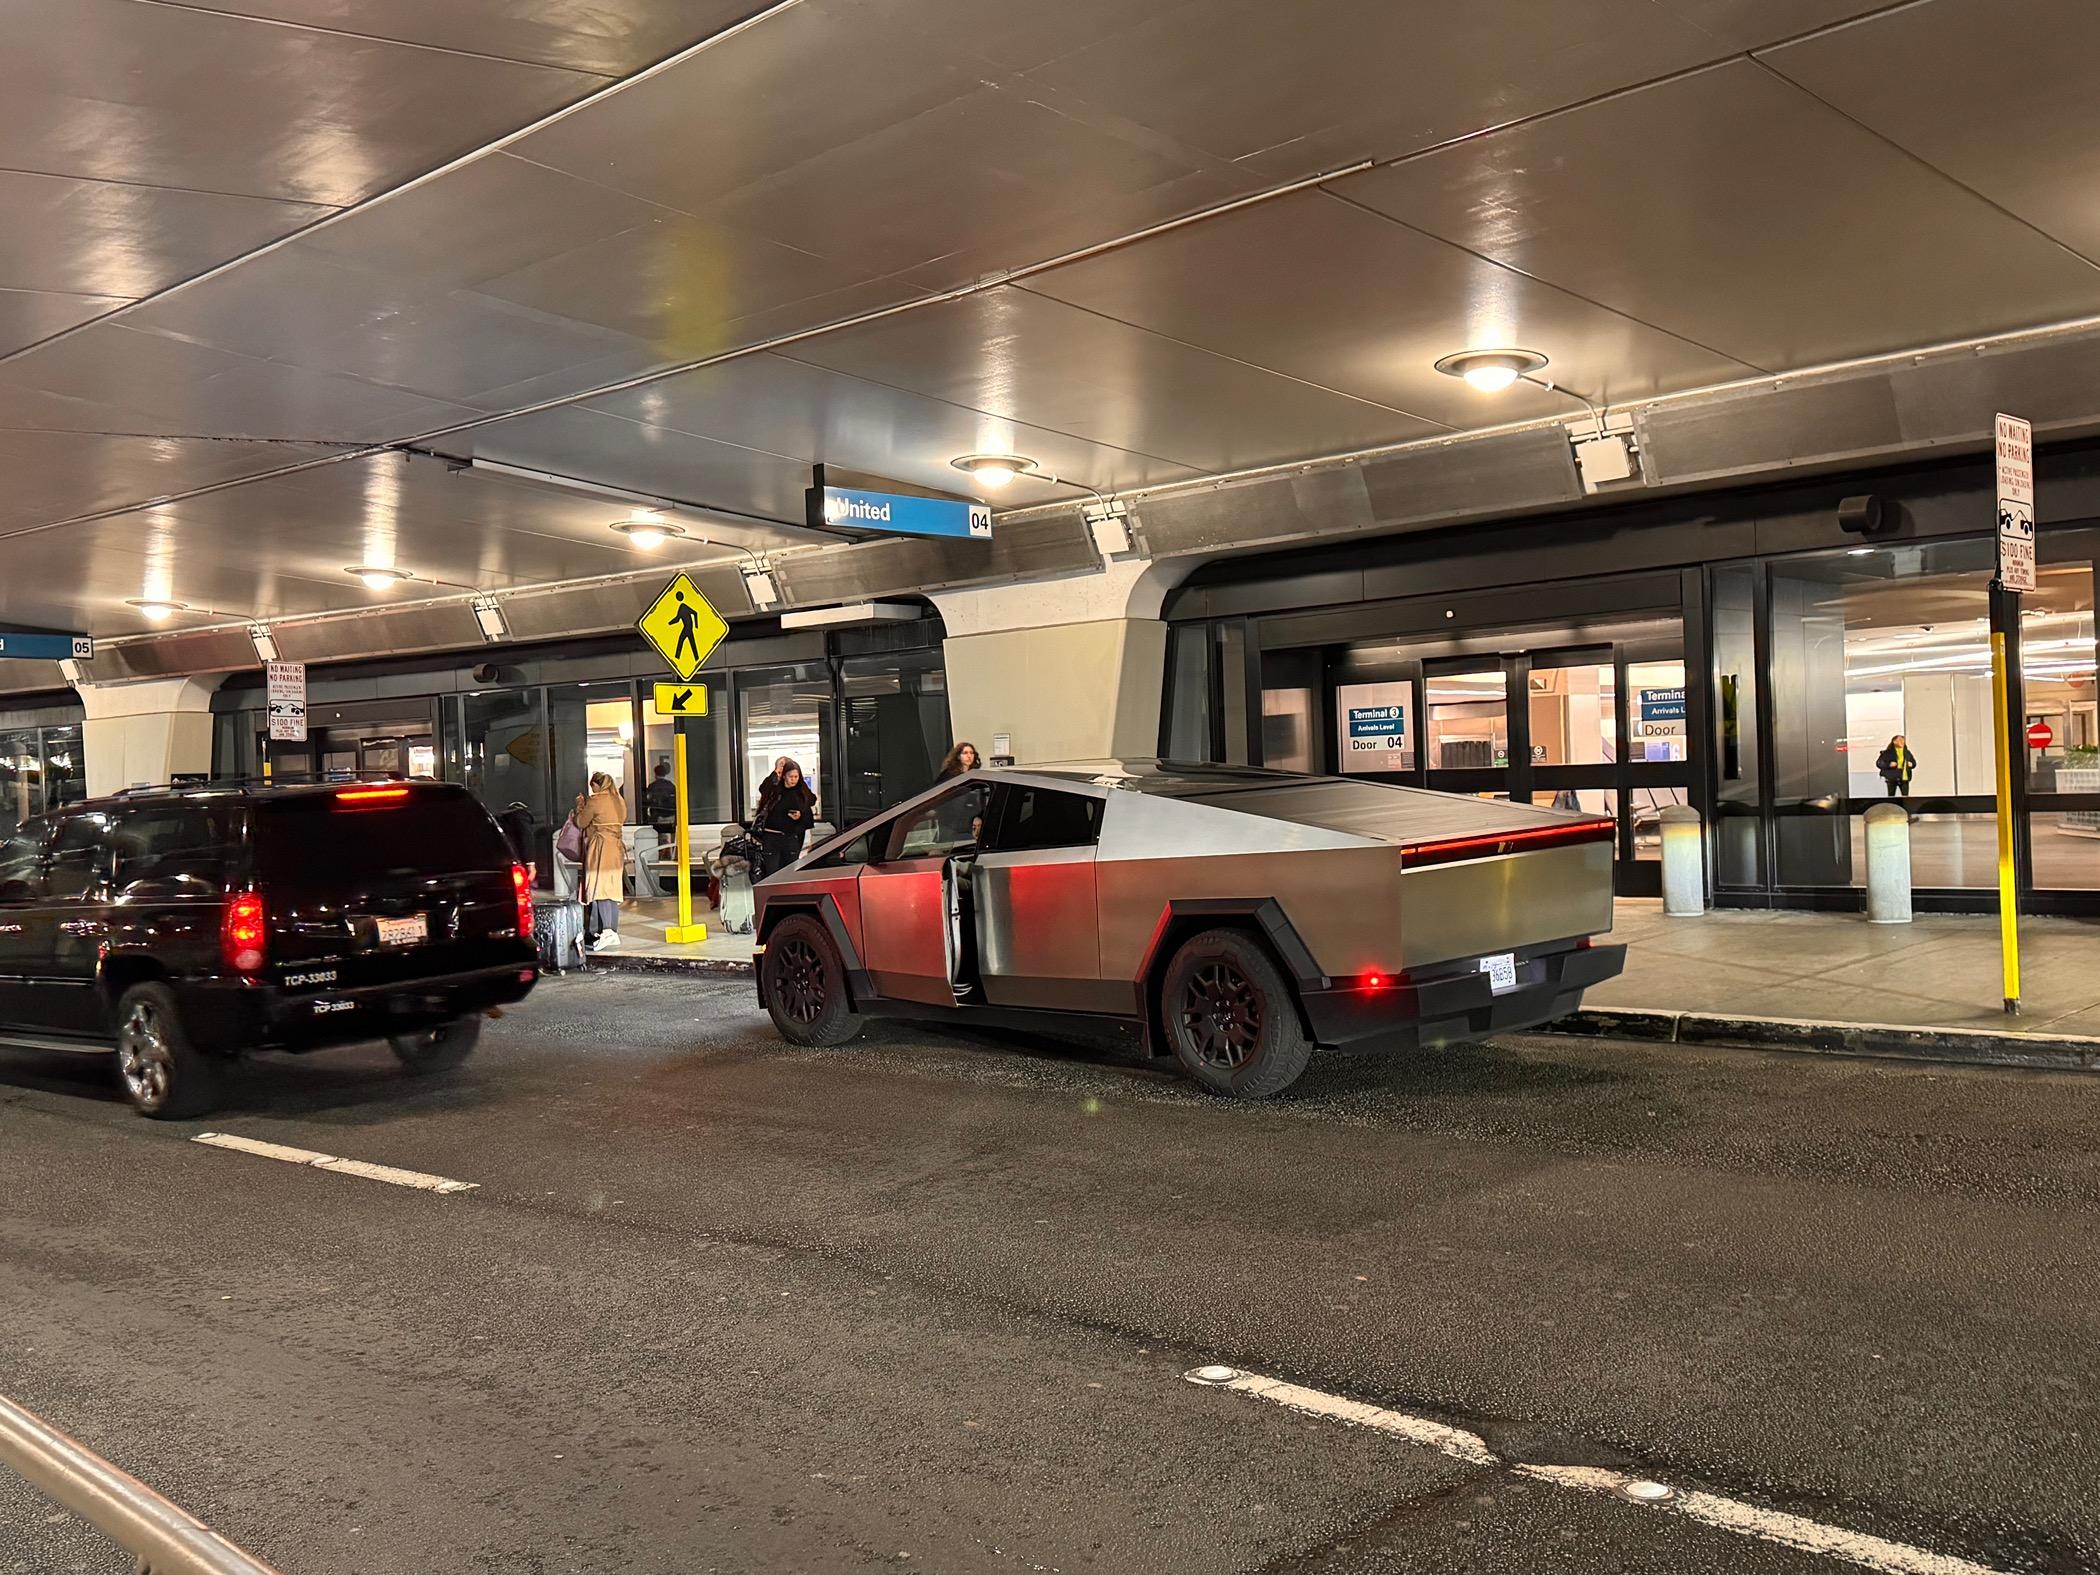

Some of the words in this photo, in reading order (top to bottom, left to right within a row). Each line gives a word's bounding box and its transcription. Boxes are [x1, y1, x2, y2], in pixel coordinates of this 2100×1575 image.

[1999, 422, 2007, 438] NO
[2008, 424, 2029, 444] WAITING
[1998, 441, 2006, 458] NO
[2008, 443, 2030, 464] PARKING
[836, 497, 891, 522] United
[971, 513, 989, 531] 04
[2019, 544, 2033, 560] FINE
[74, 642, 90, 654] 05
[270, 665, 279, 673] NO
[280, 665, 302, 674] WAITING
[270, 674, 278, 682] NO
[279, 674, 303, 683] PARKING
[1353, 708, 1388, 720] Terminal
[1651, 707, 1680, 715] Arrivals
[290, 718, 304, 727] FINE
[1645, 724, 1677, 736] Door
[1352, 740, 1378, 750] Door
[1387, 736, 1403, 748] 04
